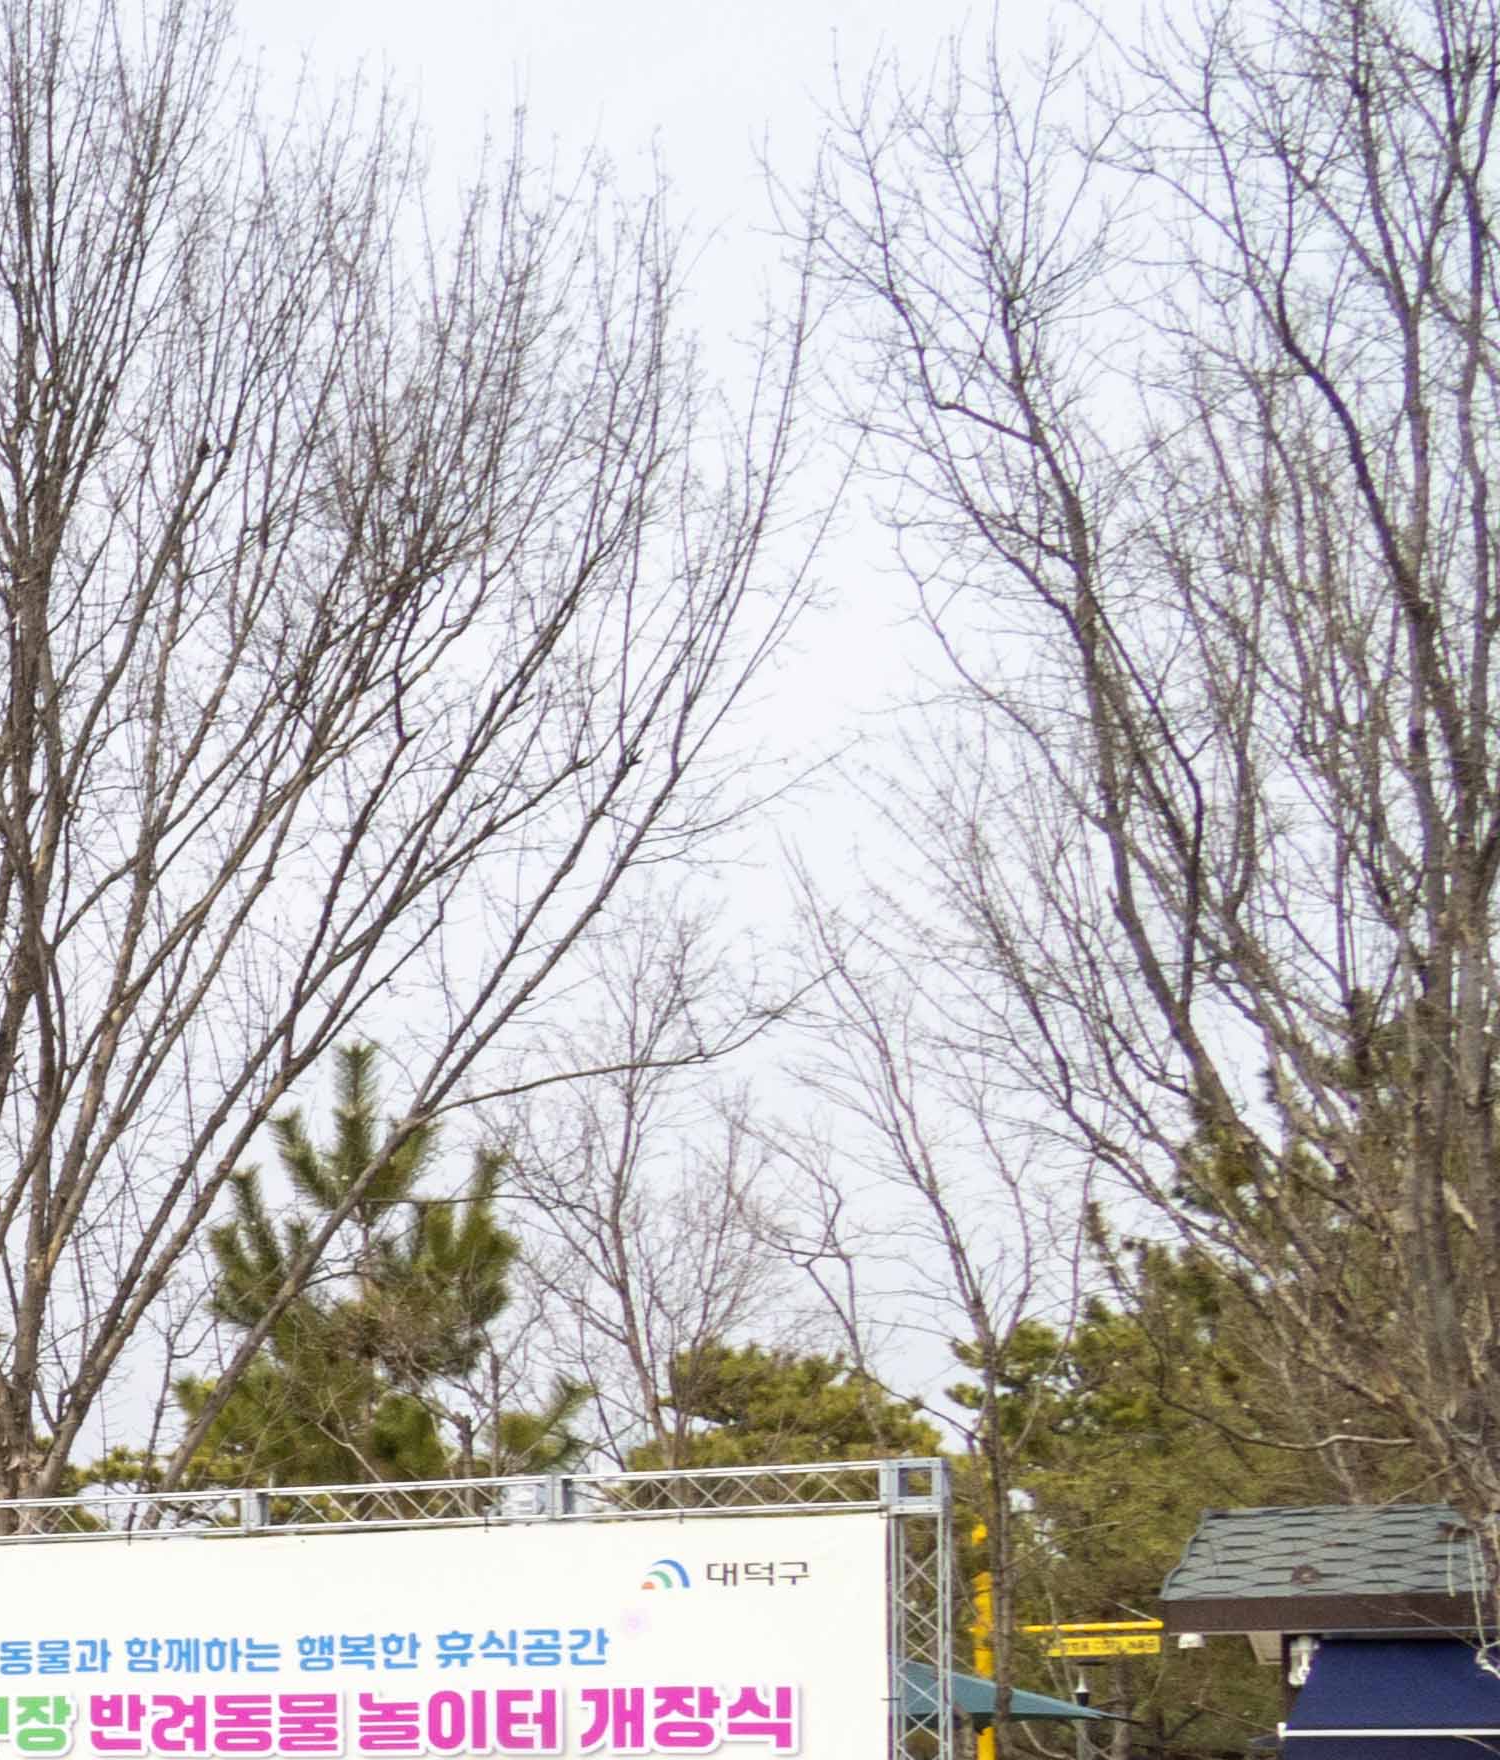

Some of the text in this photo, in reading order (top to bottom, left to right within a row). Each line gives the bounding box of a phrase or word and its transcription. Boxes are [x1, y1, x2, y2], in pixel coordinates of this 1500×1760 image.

[707, 1562, 809, 1586] 대덕구
[126, 1638, 280, 1672] 함께하는
[298, 1633, 420, 1671] 행복한
[438, 1629, 609, 1668] 휴식공간
[91, 1695, 337, 1751] 반려동물
[360, 1690, 556, 1749] 놀이터
[582, 1687, 791, 1748] 개장식
